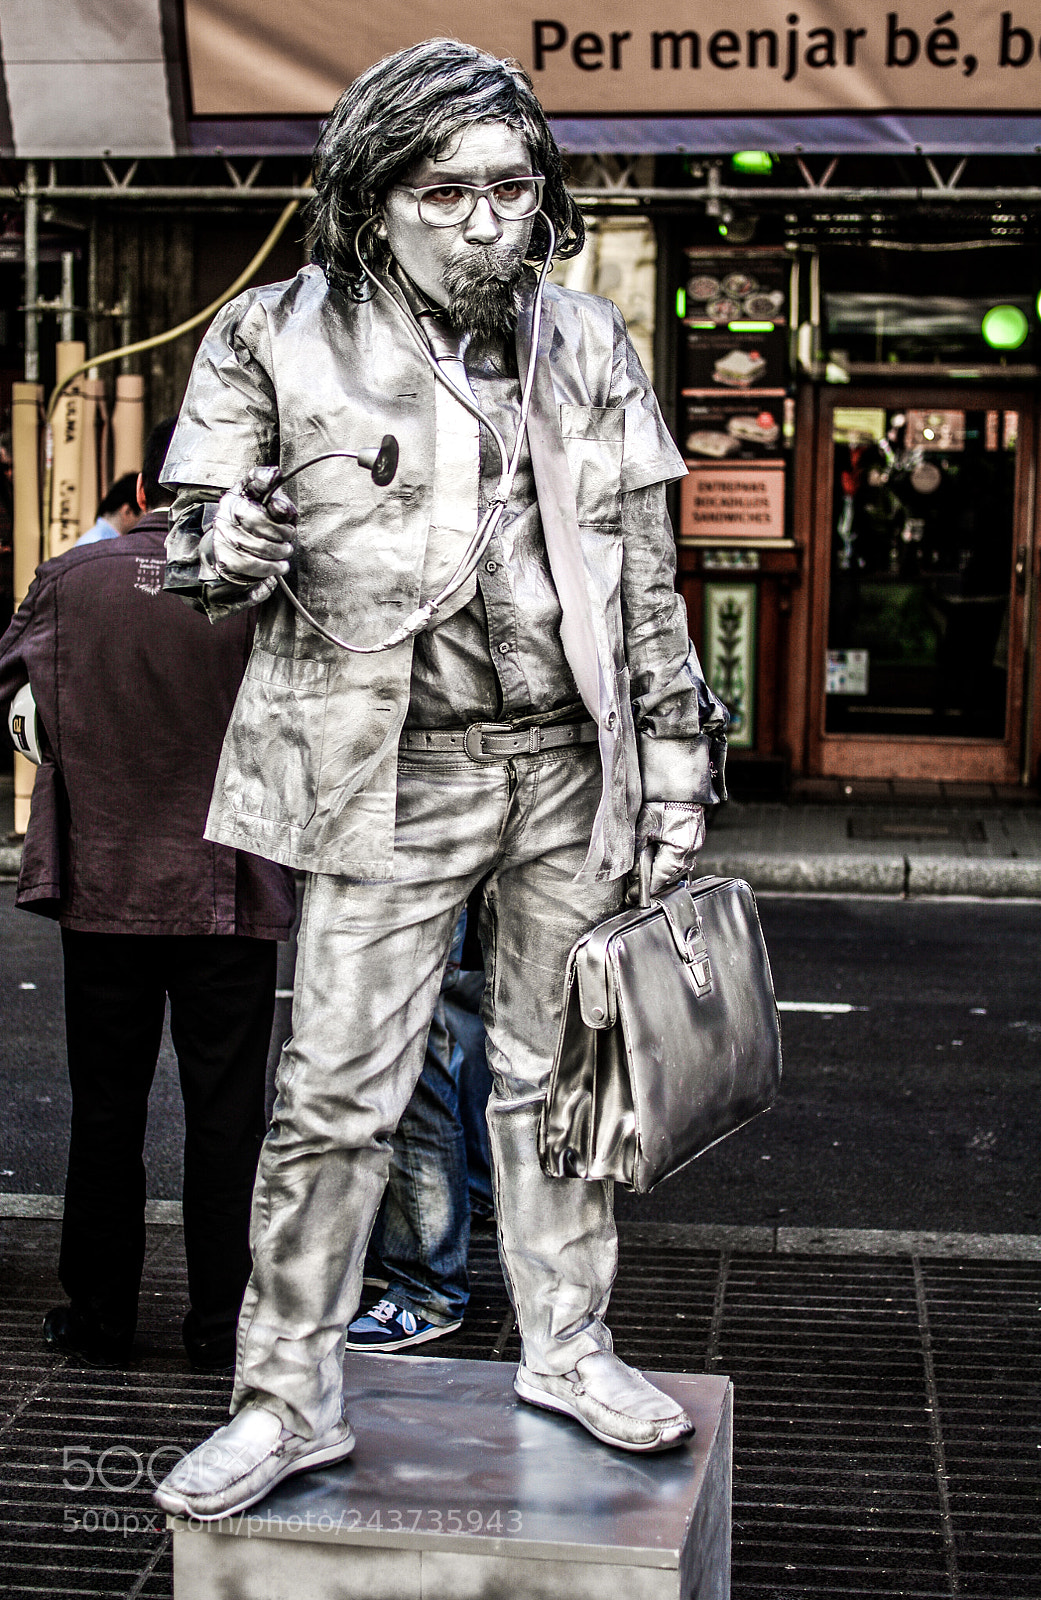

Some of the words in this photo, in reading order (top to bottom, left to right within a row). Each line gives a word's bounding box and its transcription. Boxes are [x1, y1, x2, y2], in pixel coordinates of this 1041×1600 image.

[532, 19, 632, 71] Per
[651, 13, 867, 82] menjar
[885, 11, 979, 78] bé,
[998, 11, 1041, 68] b
